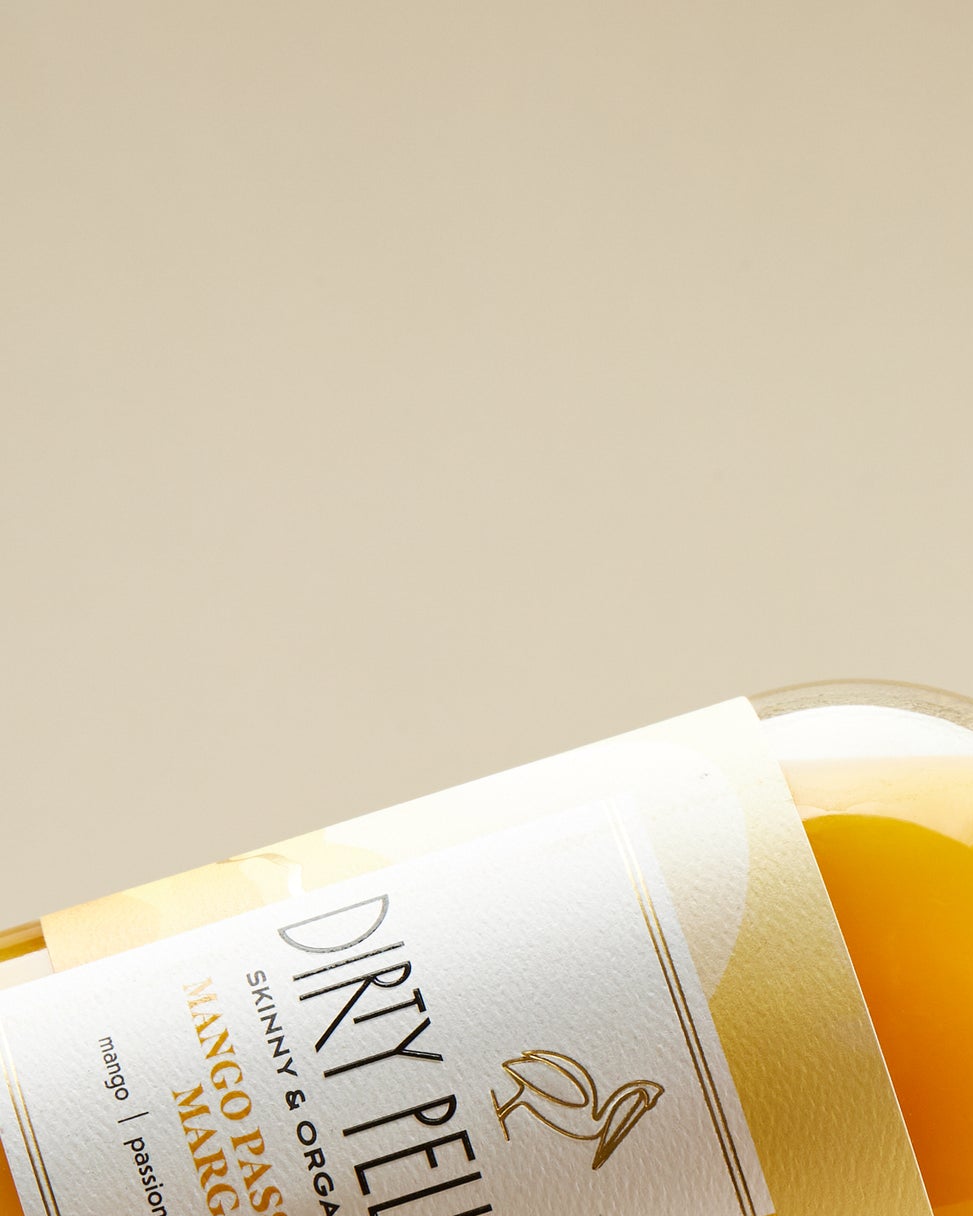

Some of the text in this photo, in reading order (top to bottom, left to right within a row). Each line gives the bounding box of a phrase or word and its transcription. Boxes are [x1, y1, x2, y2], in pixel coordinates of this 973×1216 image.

[183, 977, 253, 1122] MANGO
[247, 971, 298, 1077] SKINNY
[285, 1090, 306, 1111] &
[278, 895, 444, 1078] DIRTY
[99, 1037, 129, 1100] mango
